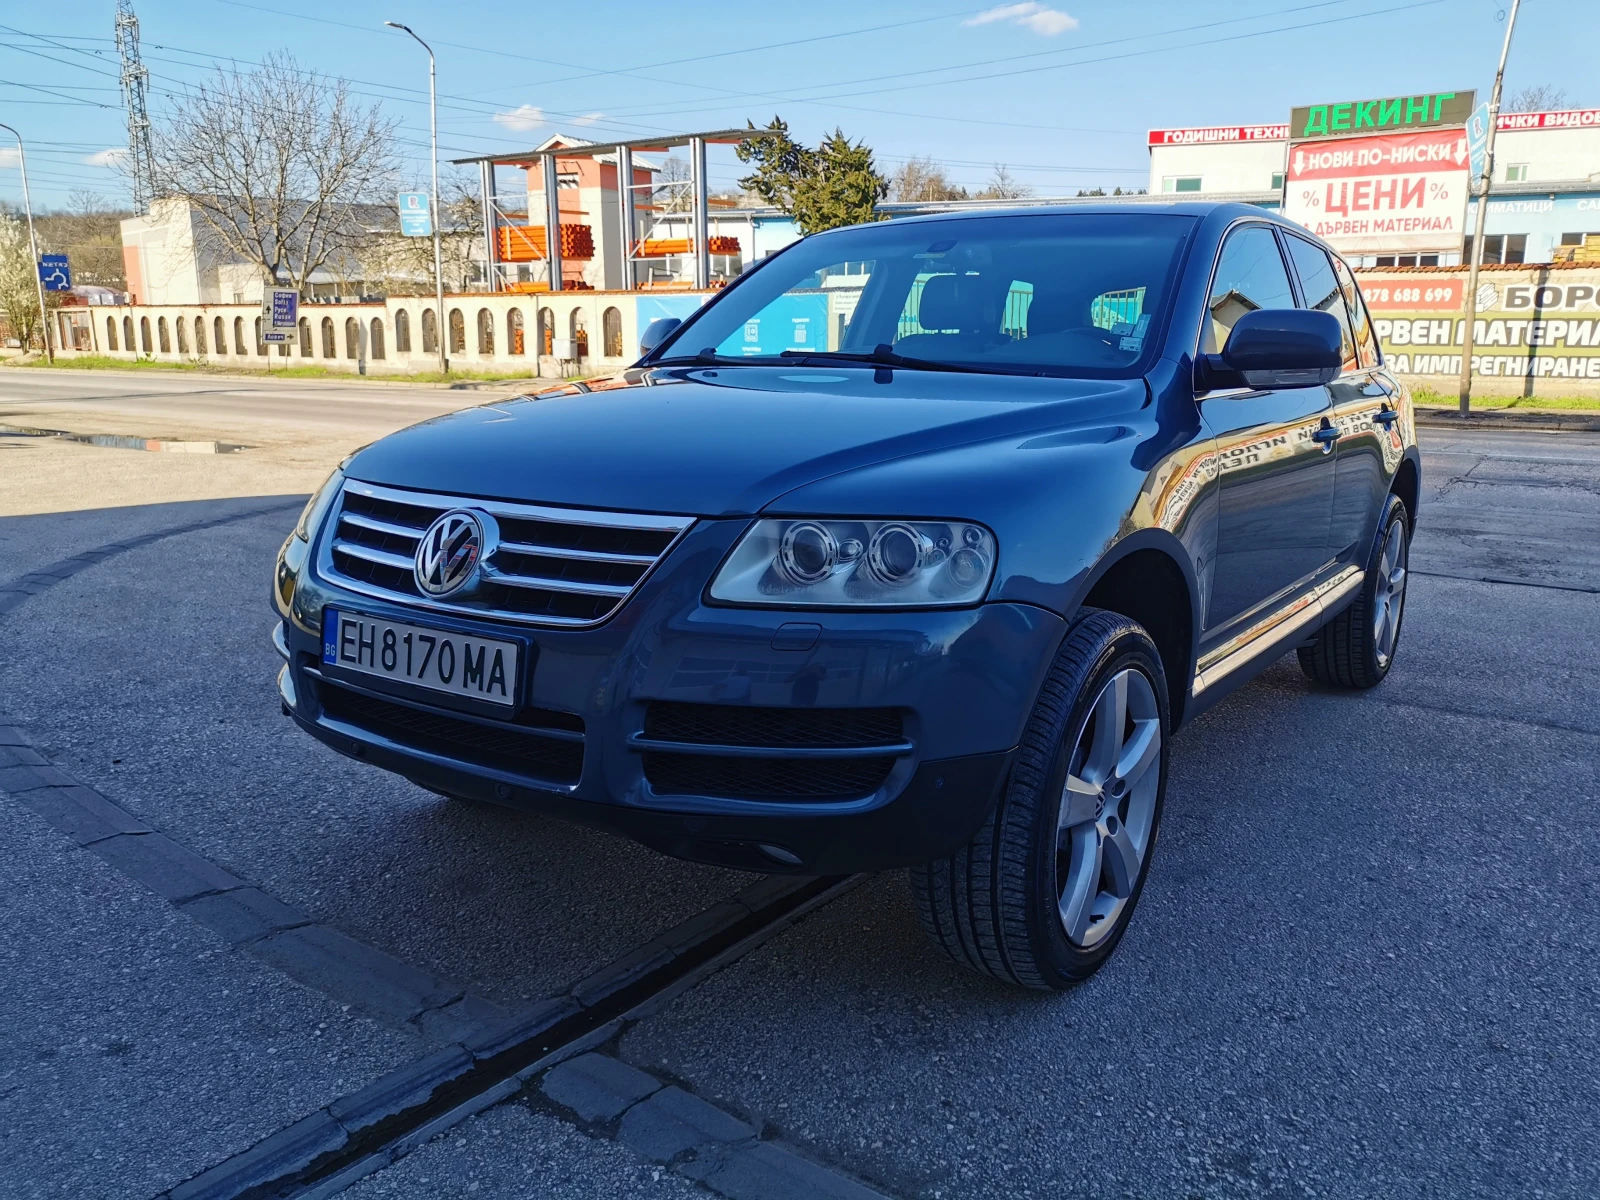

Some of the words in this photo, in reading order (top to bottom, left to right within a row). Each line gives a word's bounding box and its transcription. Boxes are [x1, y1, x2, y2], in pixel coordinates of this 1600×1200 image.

[1304, 93, 1455, 137] ДЕКИНГ
[1163, 128, 1240, 143] ГОДИШНИ
[1309, 152, 1353, 170] НОВИ
[1357, 144, 1451, 167] ПО-НИСКИ
[1325, 177, 1426, 217] ЦЕНИ
[1468, 200, 1553, 214] КИМАТИЦИ
[1577, 199, 1600, 211] СА
[1315, 220, 1370, 238] ДЪРВЕН
[1373, 215, 1453, 233] МАТЕРИАЛ
[1393, 288, 1421, 303] 688
[1424, 287, 1453, 303] 699
[1504, 285, 1600, 309] БОР
[325, 643, 336, 657] BG
